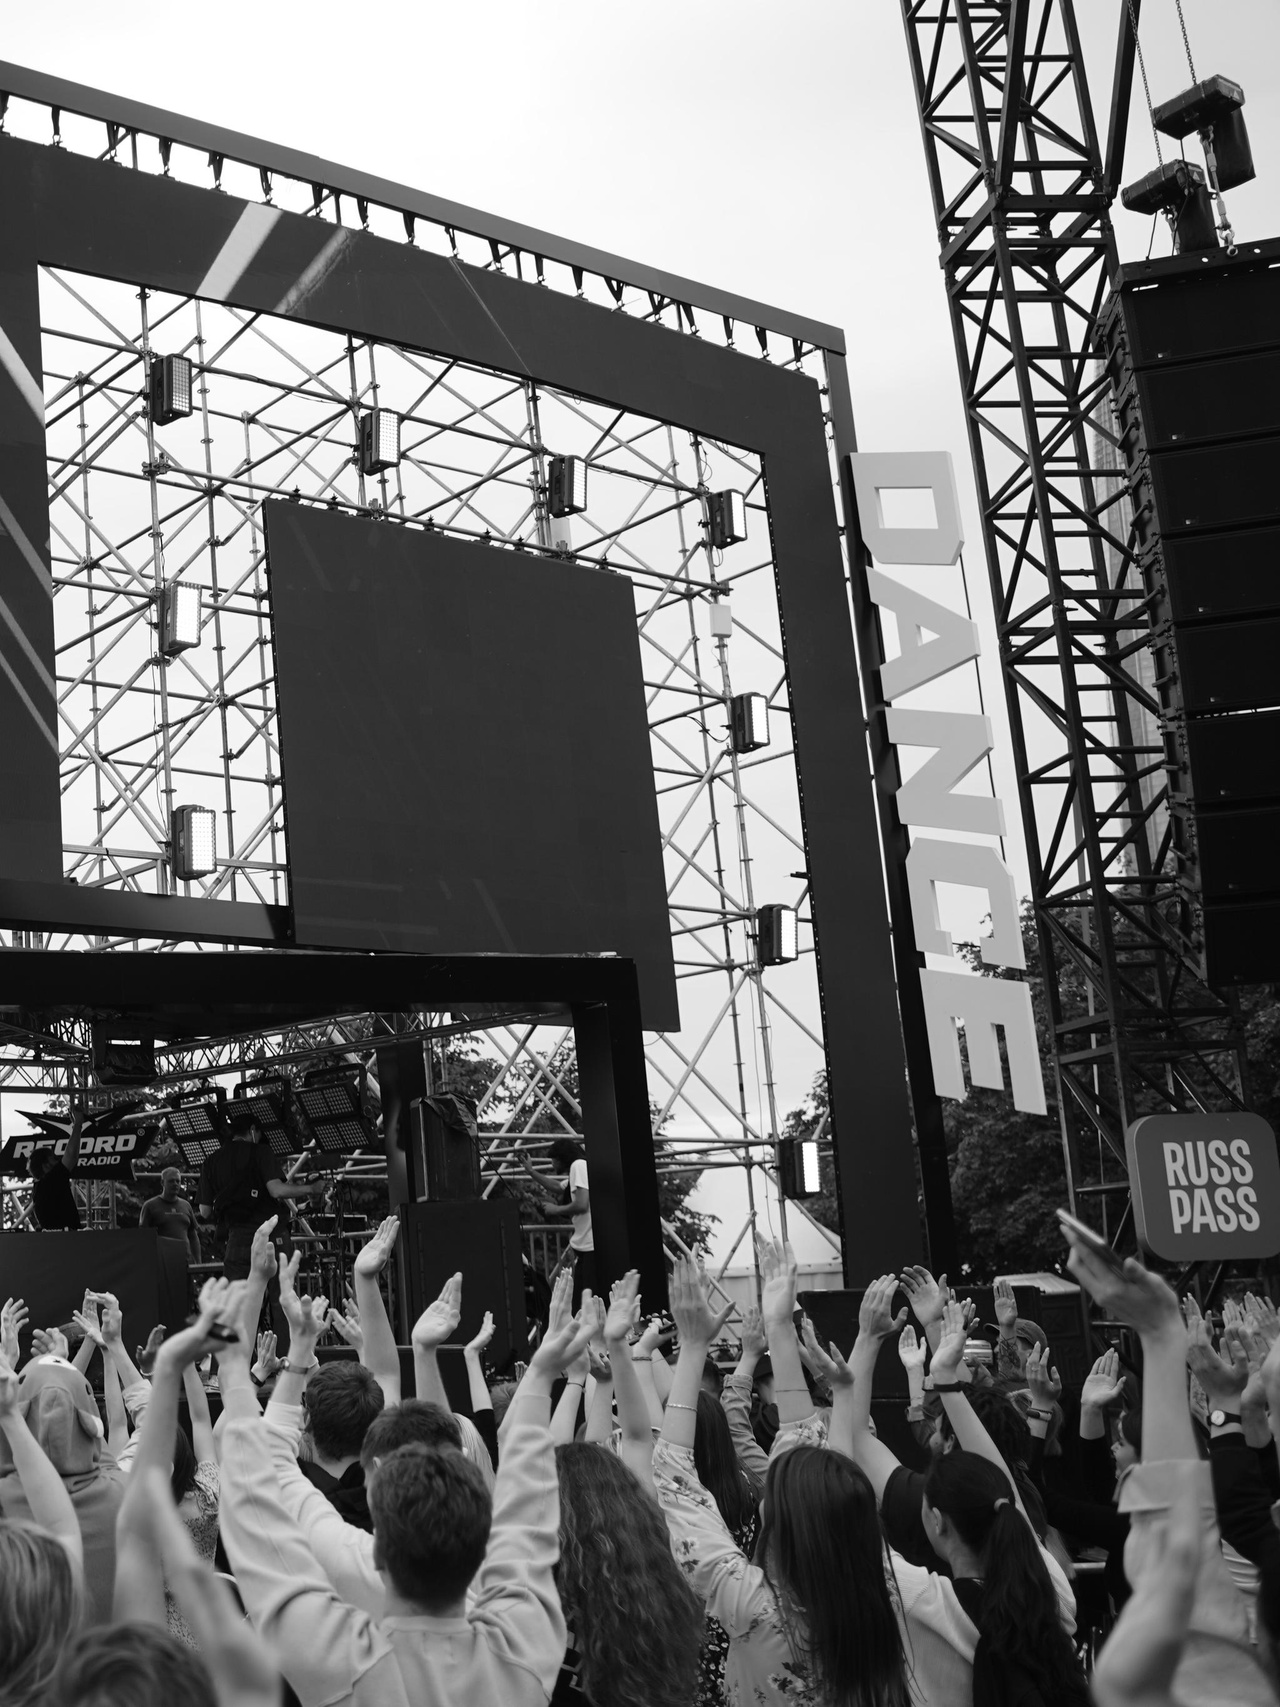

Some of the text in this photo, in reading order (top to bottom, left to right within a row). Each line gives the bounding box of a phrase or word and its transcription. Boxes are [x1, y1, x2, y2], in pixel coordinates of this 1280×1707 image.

[850, 451, 1047, 1116] DANCE
[77, 1155, 121, 1167] RADIO
[1163, 1139, 1253, 1186] RUSS
[1169, 1186, 1260, 1234] PASS
